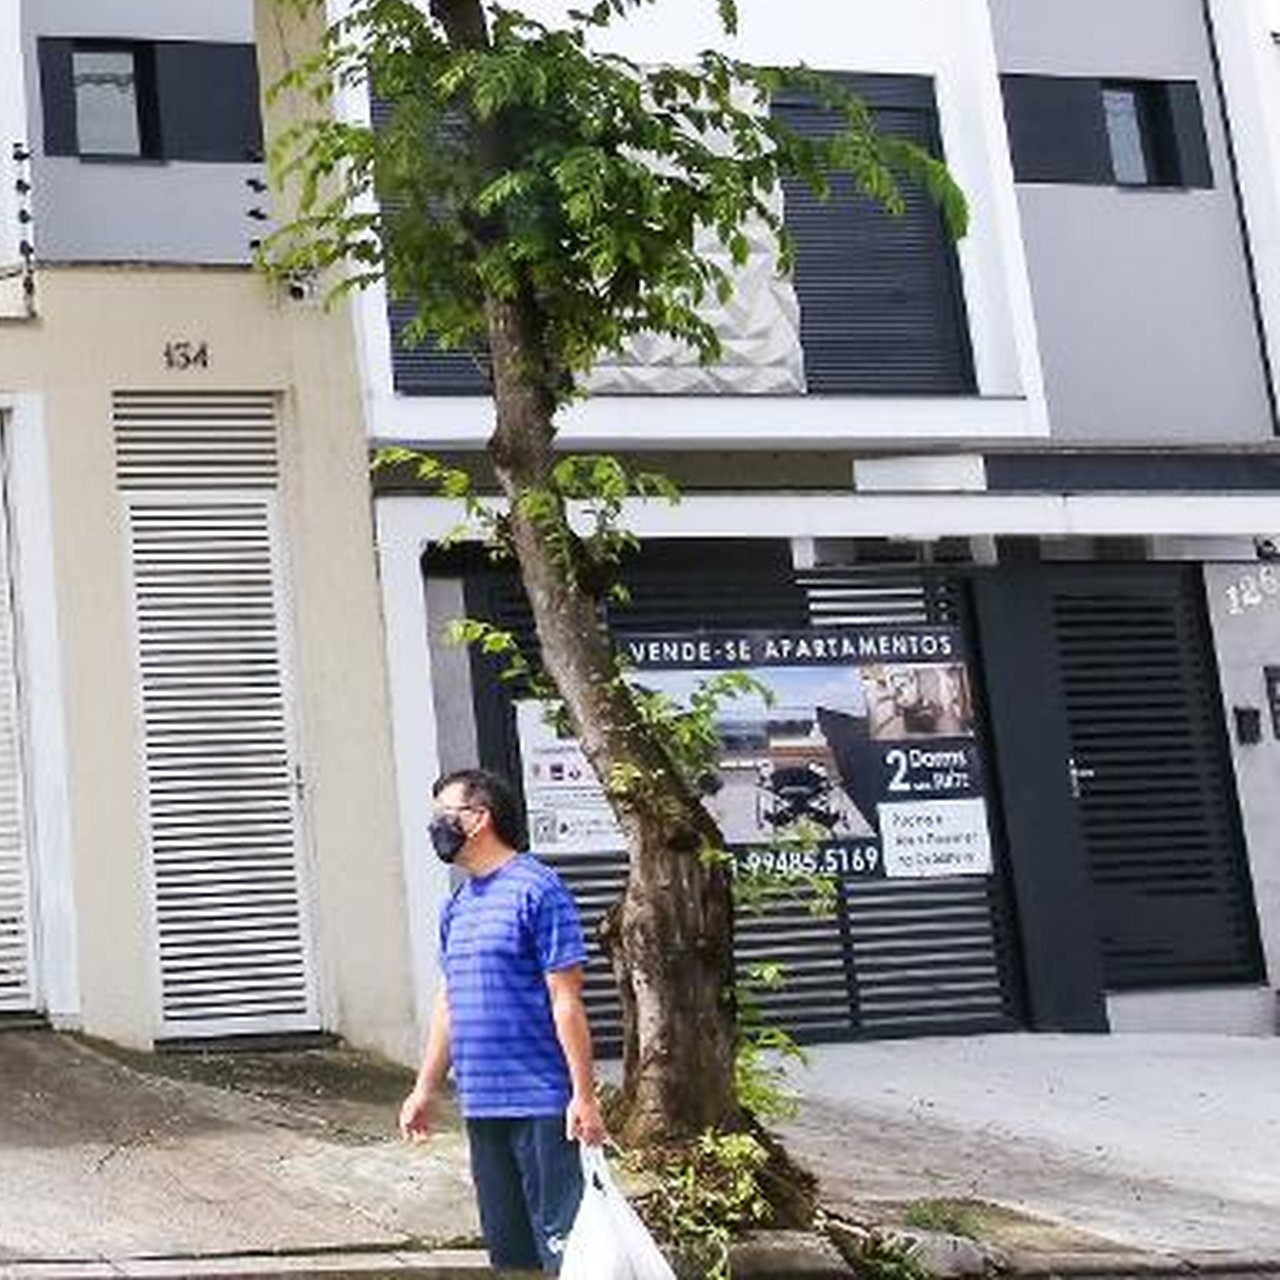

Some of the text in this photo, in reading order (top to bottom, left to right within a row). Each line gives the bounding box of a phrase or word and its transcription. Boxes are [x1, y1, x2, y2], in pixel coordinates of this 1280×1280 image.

[629, 635, 953, 663] VENDE-SE APARTAMENTOS
[886, 749, 911, 791] 2
